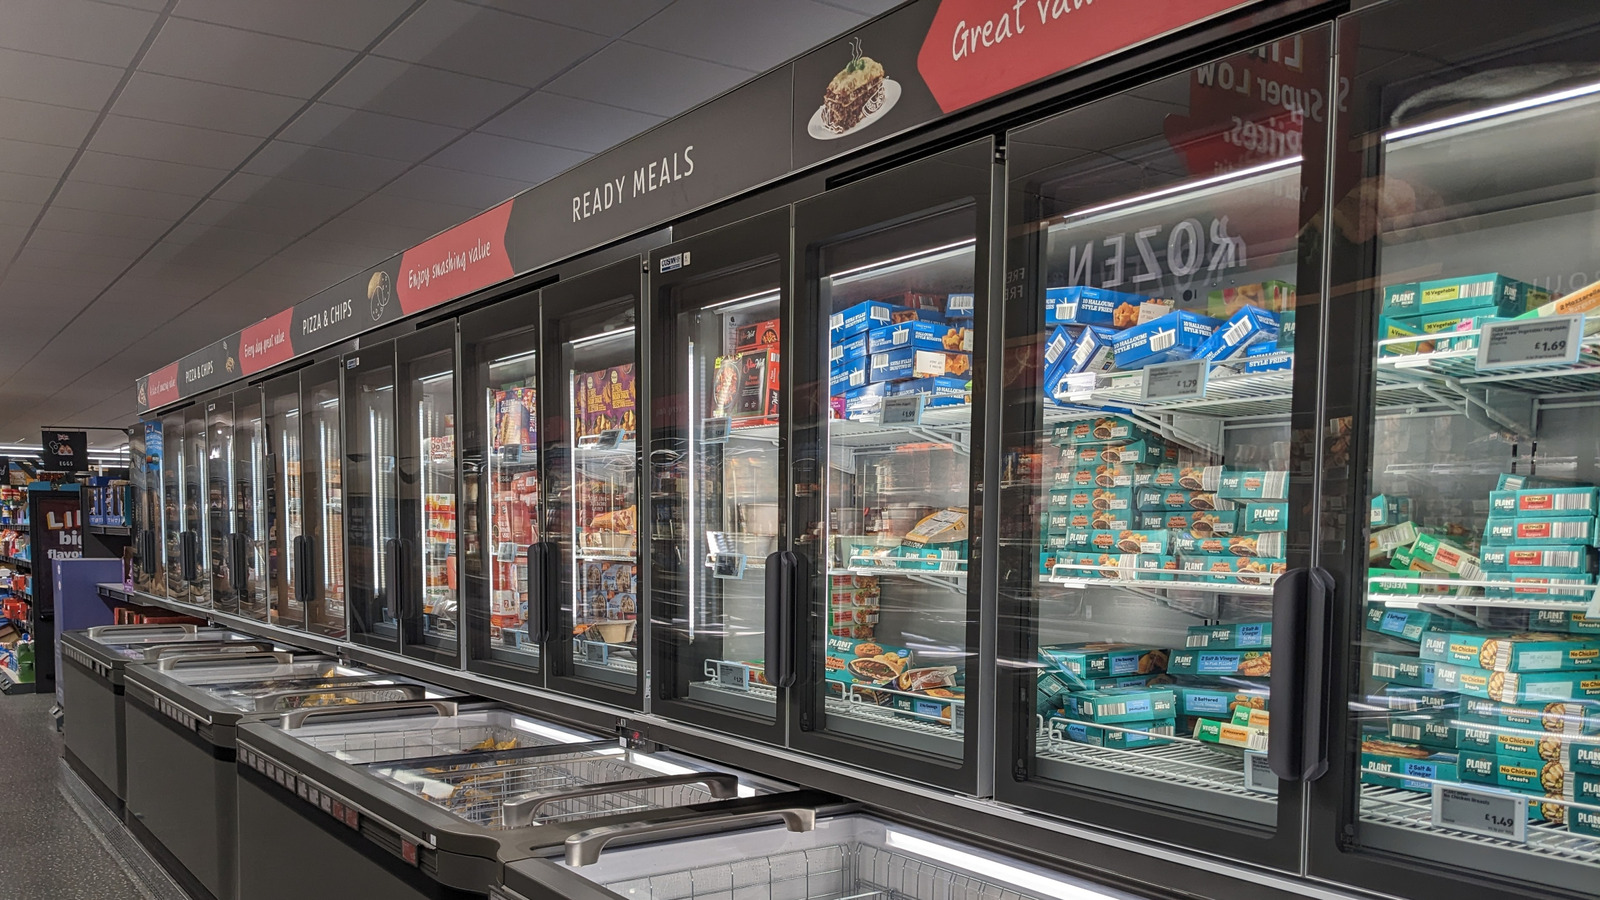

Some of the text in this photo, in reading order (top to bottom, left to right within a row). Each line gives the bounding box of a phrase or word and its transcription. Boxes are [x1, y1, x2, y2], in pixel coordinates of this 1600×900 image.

[952, 0, 1026, 61] Great
[572, 146, 694, 222] READY MEALS
[408, 238, 491, 290] Enjoy smashing value
[1392, 293, 1415, 303] PLANT
[1088, 299, 1114, 308] HALLOUMI
[302, 299, 352, 335] PIZZA & CHIPS
[1188, 322, 1212, 331] HALLOUMI
[274, 329, 285, 345] value
[1121, 333, 1147, 346] HALLOUMI
[1114, 339, 1147, 354] STYLE FRIES
[1249, 357, 1288, 367] STYLE FRIES
[186, 369, 197, 384] PIZZA
[201, 360, 214, 377] CHIPS
[1254, 509, 1280, 518] PLANT
[1070, 533, 1088, 542] PLANT
[1185, 562, 1204, 570] PLANT
[1368, 609, 1383, 618] PLANT
[1539, 611, 1564, 620] PLANT
[829, 639, 853, 648] PLANT
[1426, 639, 1445, 648] PLANT
[1400, 664, 1418, 672] PLANT
[1438, 669, 1456, 679] PLANT
[1422, 696, 1445, 705] PLANT
[1468, 700, 1493, 712] PLANT
[1426, 724, 1448, 733] PLANT
[1466, 729, 1491, 739] PLANT
[1368, 762, 1392, 772] PLANT
[1466, 759, 1492, 769] PLANT
